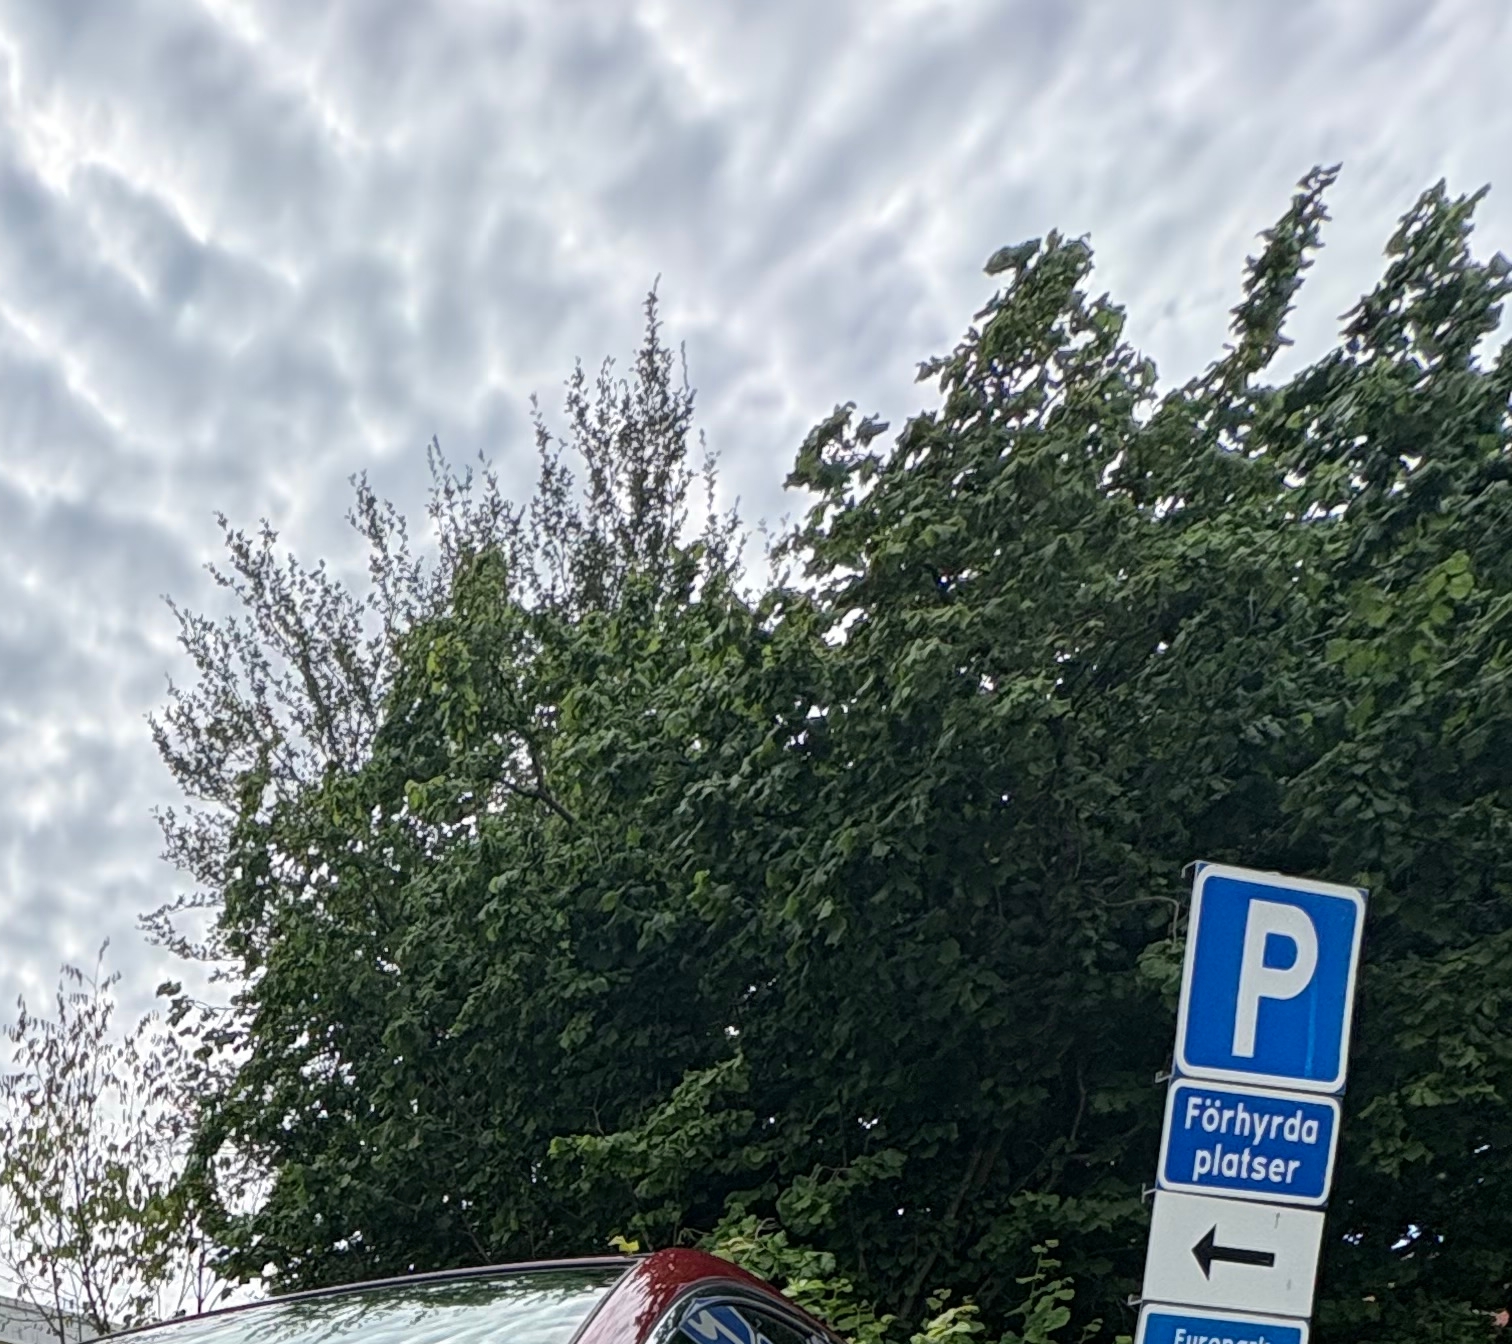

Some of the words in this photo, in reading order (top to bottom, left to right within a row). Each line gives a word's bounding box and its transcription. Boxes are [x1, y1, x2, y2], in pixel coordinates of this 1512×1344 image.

[1231, 898, 1319, 1059] P
[1184, 1096, 1319, 1145] Förhyrda
[1191, 1142, 1301, 1184] platser
